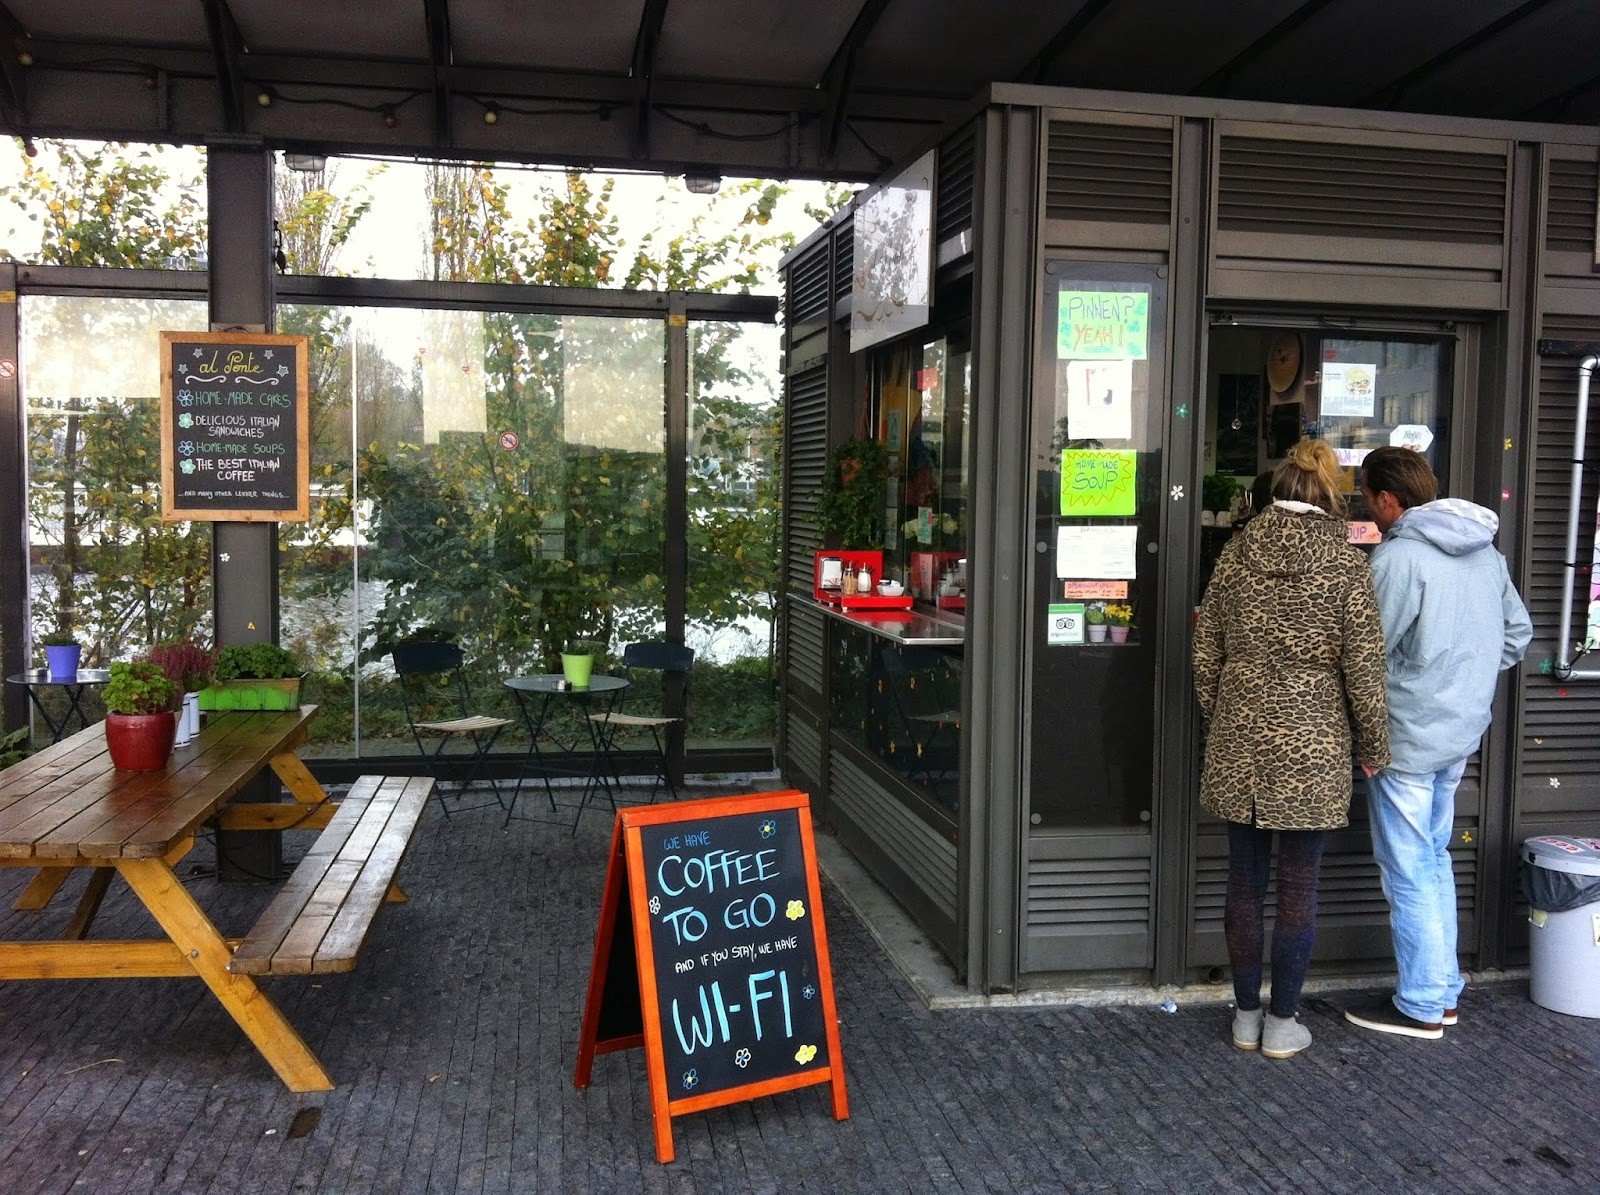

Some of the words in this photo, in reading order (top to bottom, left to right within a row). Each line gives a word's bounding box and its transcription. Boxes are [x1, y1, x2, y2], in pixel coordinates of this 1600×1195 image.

[1068, 296, 1135, 324] PINNEN?
[199, 350, 219, 374] al
[223, 350, 264, 375] Ponte
[194, 390, 254, 407] HOME-MADE
[259, 392, 292, 408] CAKES
[195, 414, 246, 426] DELICIOUS
[250, 414, 281, 430] ITALIAN
[208, 426, 264, 438] SANDWICHES
[196, 441, 247, 454] HOME-MADE
[253, 443, 286, 455] SOUPS
[196, 457, 214, 470] THE
[217, 458, 246, 470] BEST
[249, 457, 280, 472] ITALIAN
[1075, 460, 1096, 469] HOME
[1100, 460, 1118, 470] MADE
[216, 470, 255, 481] COFFEE
[1346, 526, 1367, 540] OUP
[663, 835, 681, 850] WE
[685, 830, 710, 847] HAVE
[657, 848, 780, 897] COFFEE
[662, 906, 708, 946] TO
[723, 892, 776, 930] GO
[675, 959, 695, 974] AND
[700, 954, 710, 967] IF
[711, 948, 729, 967] YOU
[758, 943, 773, 956] WE
[775, 936, 798, 950] HAVE
[672, 969, 794, 1056] WI-FI
